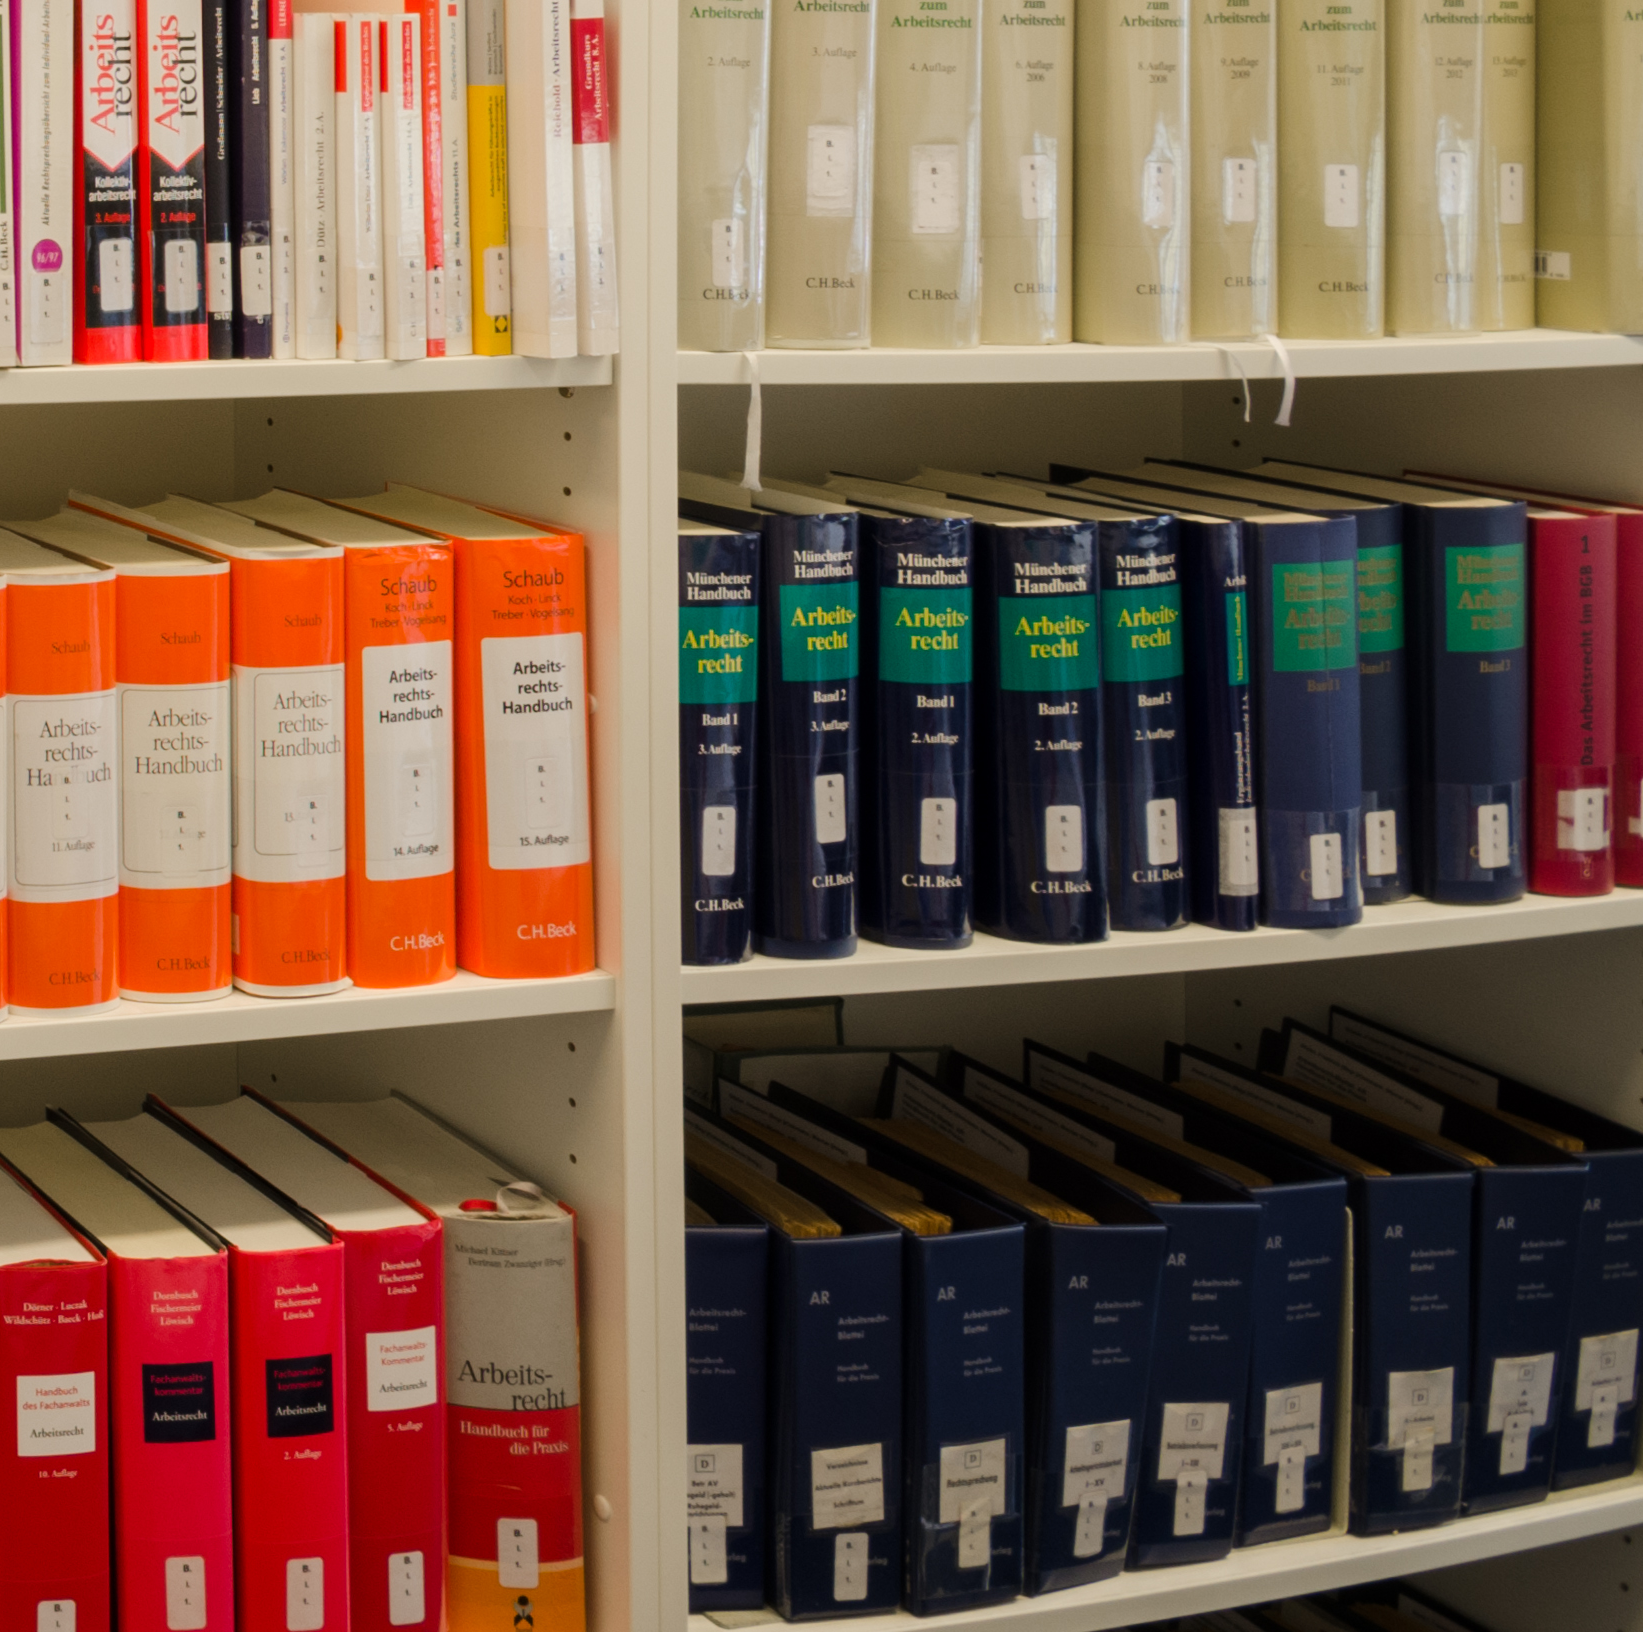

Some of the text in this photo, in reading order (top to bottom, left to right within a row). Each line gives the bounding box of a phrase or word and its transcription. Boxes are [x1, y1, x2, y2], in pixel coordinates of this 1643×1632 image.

[689, 6, 765, 21] Arbeitsrecht
[918, 0, 948, 11] zum
[890, 15, 972, 29] Arbeitsrecht
[89, 13, 115, 136] Arbeits
[110, 30, 133, 120] recht
[154, 14, 179, 136] Arbeits
[175, 30, 198, 120] recht
[94, 176, 131, 190] Kollektiv-
[88, 189, 137, 204] arbeitsrecht
[1014, 562, 1087, 577] Münchener
[502, 568, 565, 589] Schaub
[686, 572, 752, 586] Münchener
[1014, 577, 1087, 594] Handbuch
[686, 586, 752, 601] Handbuch
[1014, 616, 1091, 636] Arbeits-
[682, 629, 755, 650] Arbeits-
[1029, 638, 1079, 659] recht
[1580, 535, 1593, 766] Das Arbeitsrecht im BGB 1
[513, 660, 566, 676] Arbeits-
[697, 654, 743, 674] recht
[517, 680, 564, 695] rechts-
[502, 698, 573, 715] Handbuch
[1037, 702, 1078, 716] Band 2
[147, 709, 213, 728] Arbeits-
[701, 713, 739, 727] Band 1
[152, 733, 209, 752] rechts-
[134, 754, 223, 776] Handbuch
[519, 833, 570, 847] 15. Auflage
[1384, 1225, 1404, 1240] AR
[809, 1290, 831, 1306] AR
[456, 1359, 554, 1387] Arbeits-
[510, 1388, 567, 1412] recht
[152, 1409, 209, 1424] Arbeitsrecht
[459, 1420, 550, 1440] Handbuch für
[509, 1438, 570, 1456] die Praxis
